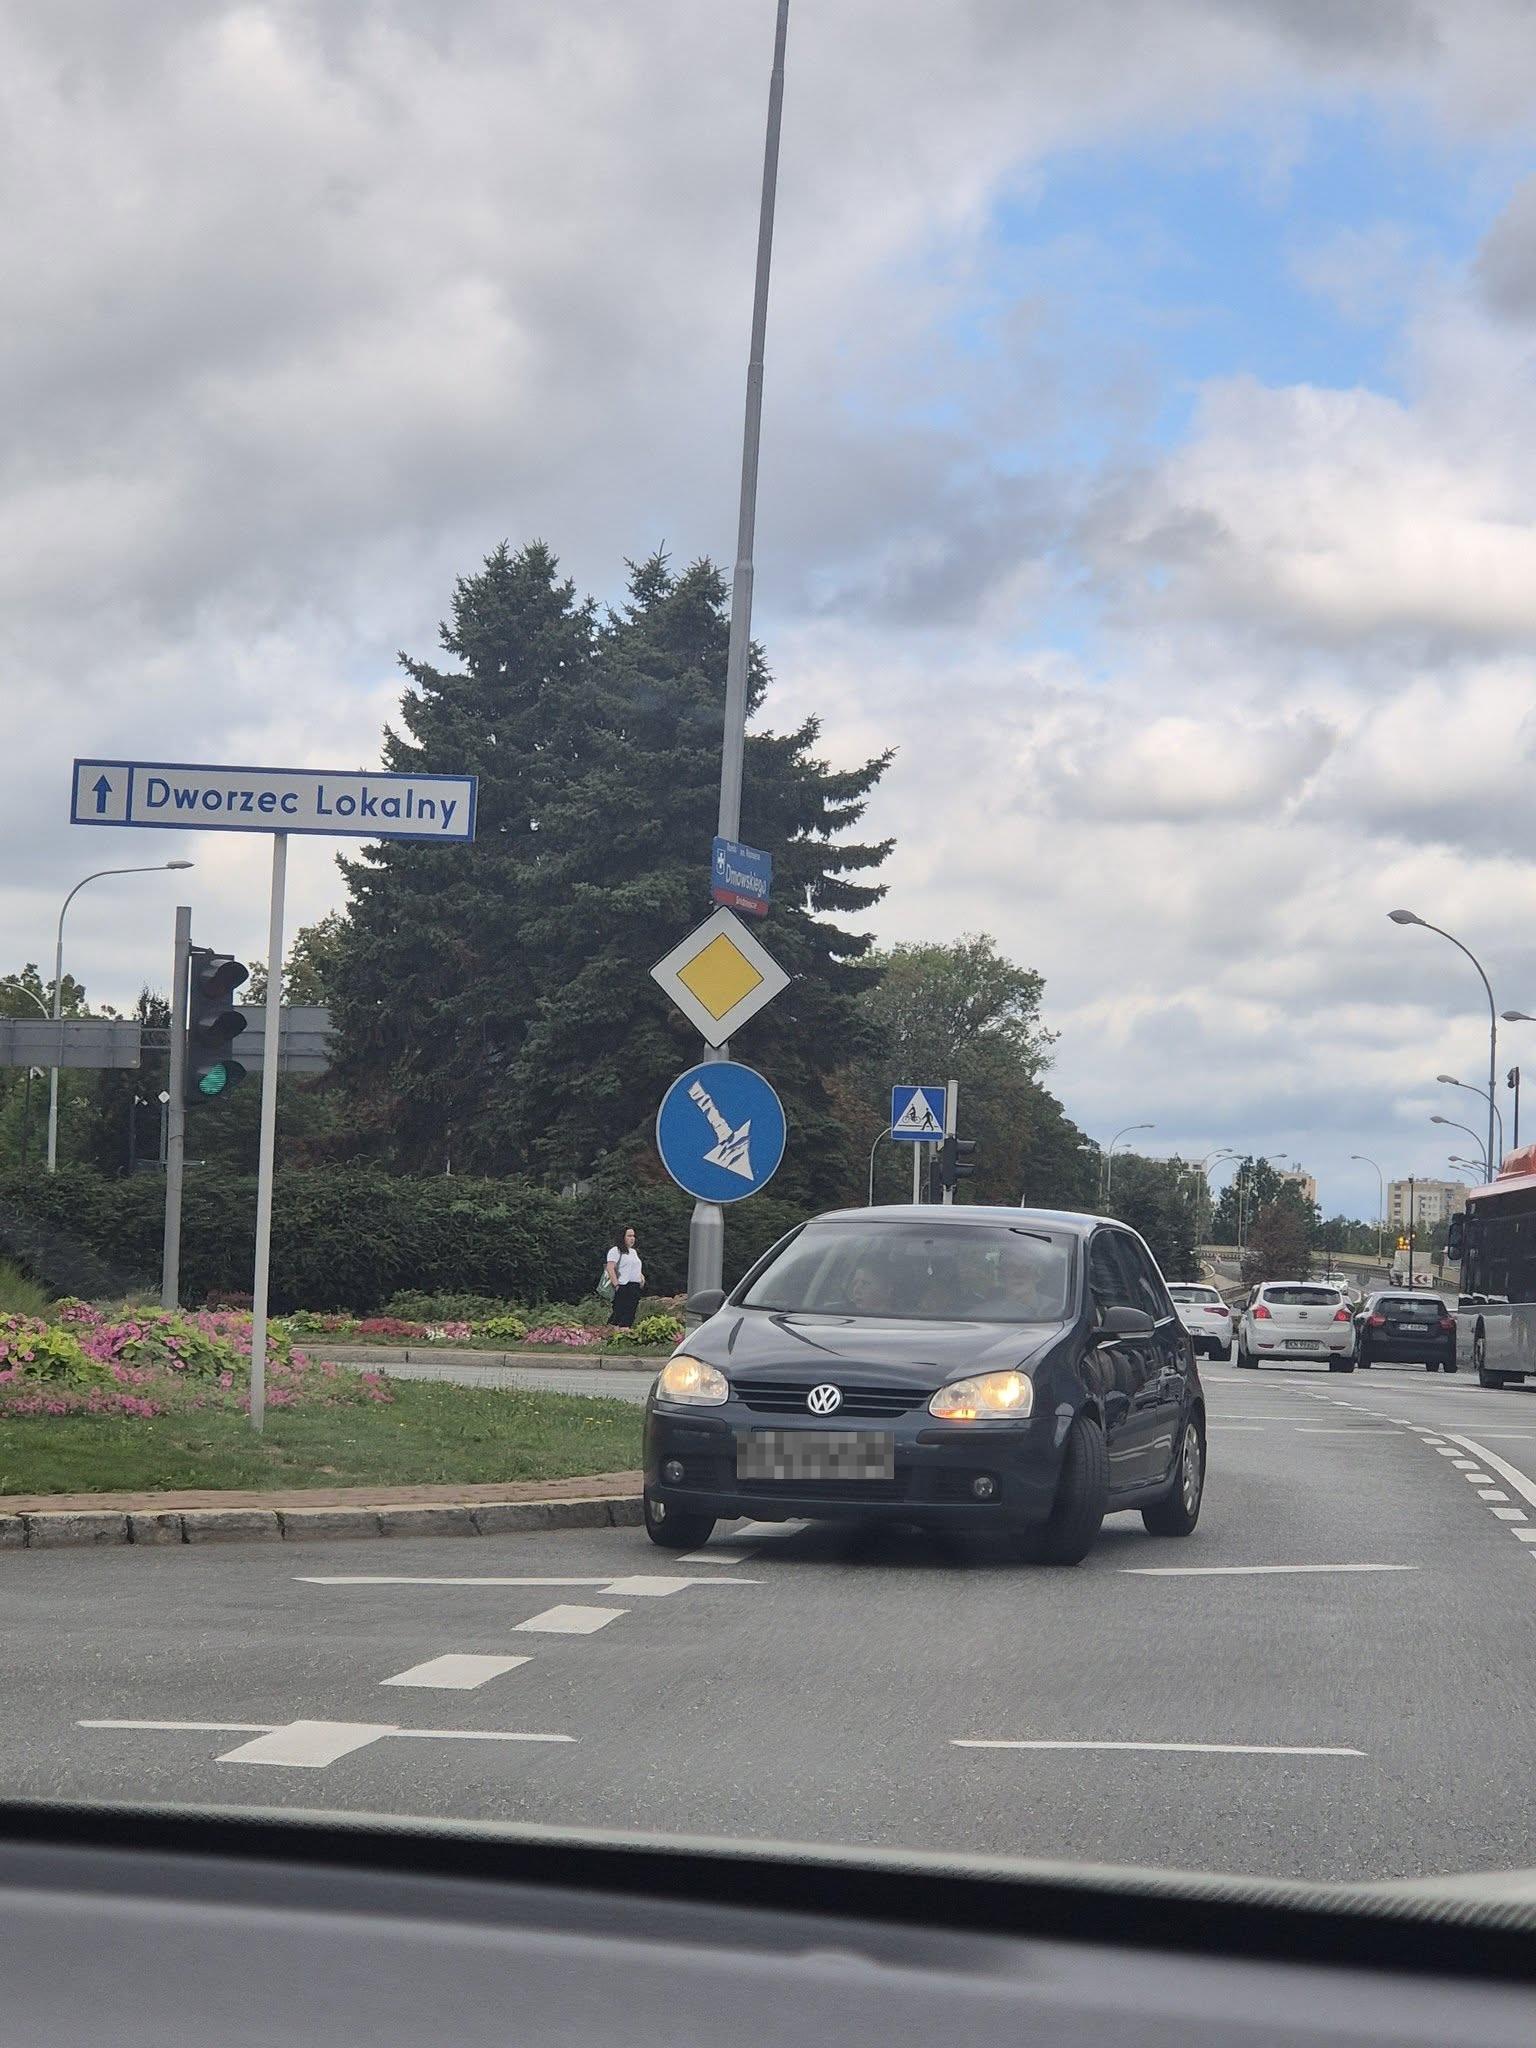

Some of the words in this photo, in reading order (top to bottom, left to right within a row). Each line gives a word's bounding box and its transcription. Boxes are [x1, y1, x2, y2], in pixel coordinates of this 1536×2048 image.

[147, 777, 299, 813] Dworzec
[317, 785, 457, 829] Lokalny
[726, 864, 767, 897] Dmowskiego
